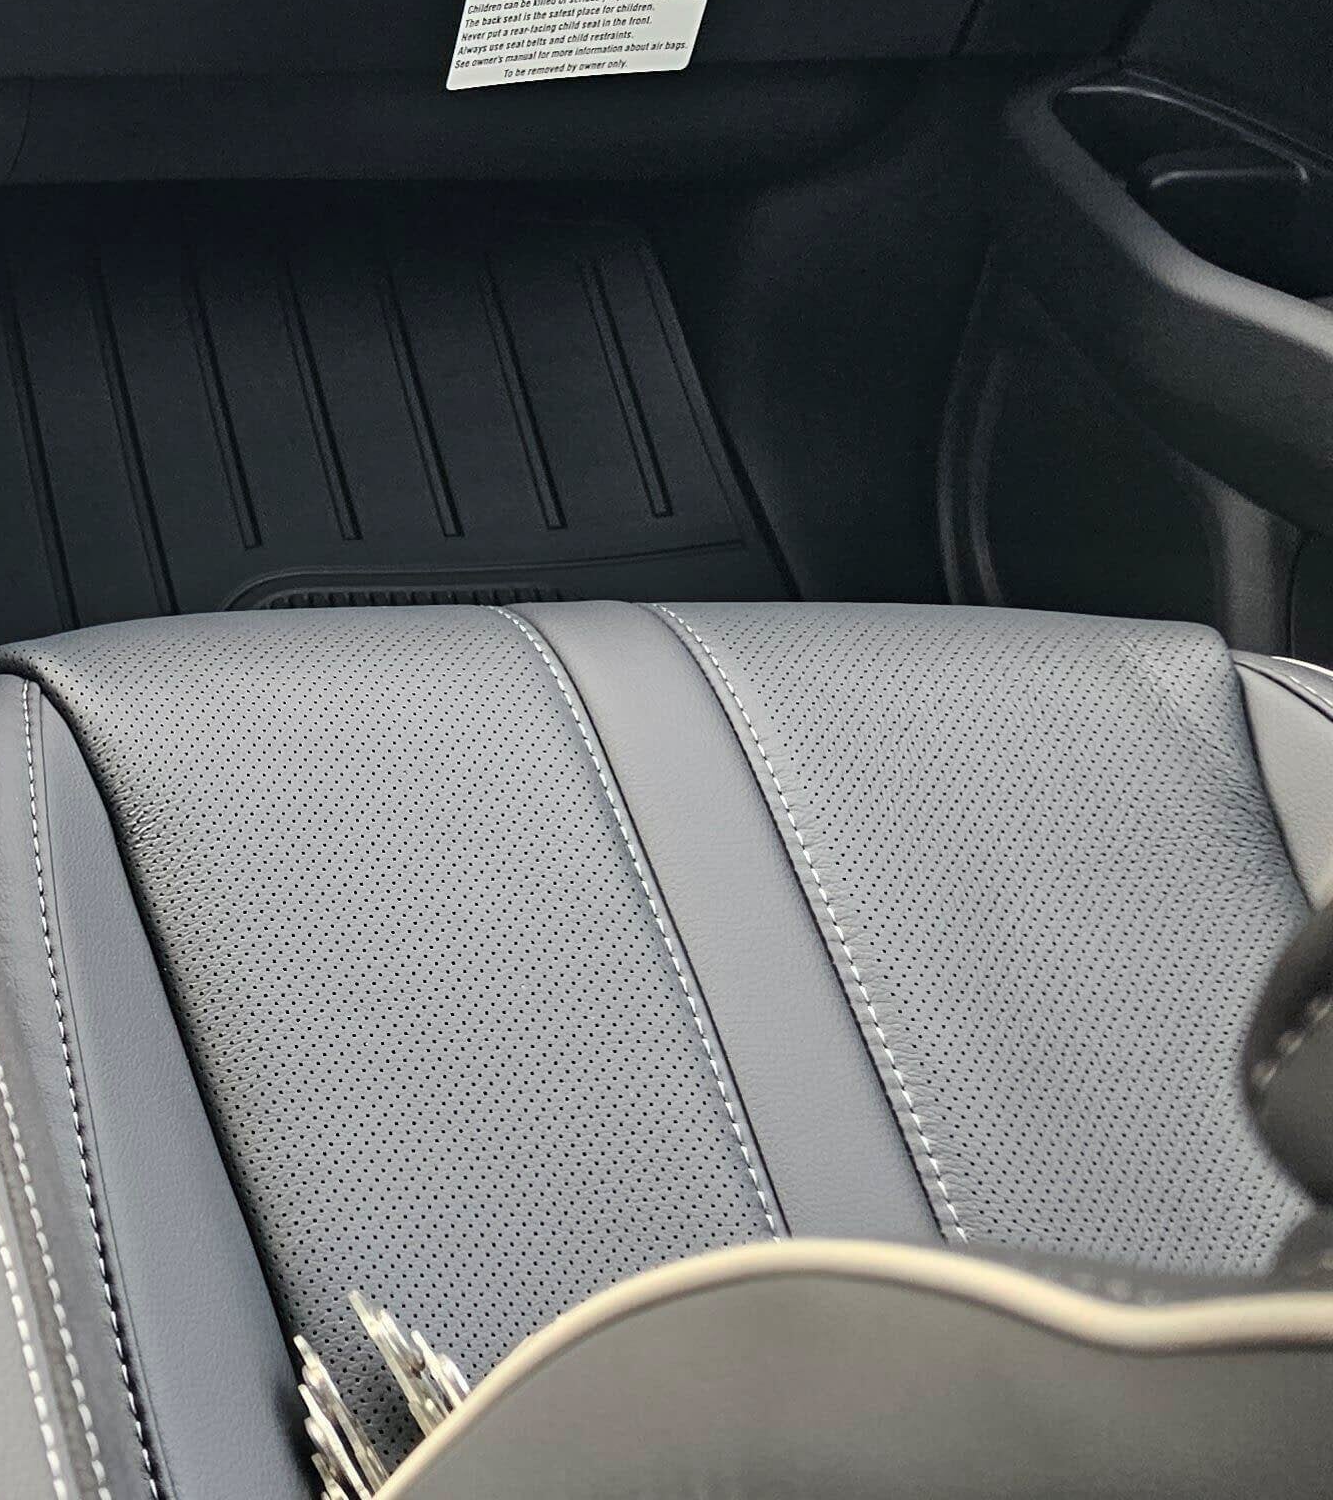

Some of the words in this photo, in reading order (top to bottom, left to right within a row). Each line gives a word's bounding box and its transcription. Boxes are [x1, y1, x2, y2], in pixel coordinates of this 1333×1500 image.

[465, 19, 479, 28] The
[482, 16, 501, 26] back
[503, 13, 521, 24] seat
[523, 12, 531, 21] is
[533, 11, 547, 20] the
[549, 9, 575, 19] safest
[576, 6, 600, 18] place
[602, 4, 615, 14] for
[617, 3, 655, 13] children.
[468, 3, 502, 14] Children
[504, 1, 518, 10] can
[520, 0, 531, 8] be
[462, 31, 485, 41] Never
[487, 29, 501, 40] put
[503, 29, 508, 37] a
[510, 24, 557, 36] rear-facing
[558, 21, 581, 31] child
[582, 20, 600, 29] seat
[602, 18, 611, 27] in
[613, 17, 627, 26] the
[629, 16, 652, 25] front.
[455, 60, 470, 69] See
[472, 56, 504, 67] owner's
[505, 51, 537, 62] manual
[538, 51, 550, 59] for
[551, 48, 573, 58] more
[575, 44, 623, 56] information
[624, 42, 649, 52] about
[650, 41, 663, 51] air
[665, 41, 688, 51] bags.
[458, 45, 487, 56] Always
[489, 42, 504, 51] use
[506, 40, 524, 50] seat
[526, 37, 546, 47] belts
[549, 36, 565, 45] and
[567, 33, 589, 43] child
[504, 69, 513, 78] To
[515, 67, 526, 76] be
[527, 64, 565, 75] removed
[566, 63, 577, 74] by
[578, 61, 605, 71] owner
[607, 59, 628, 69] only.
